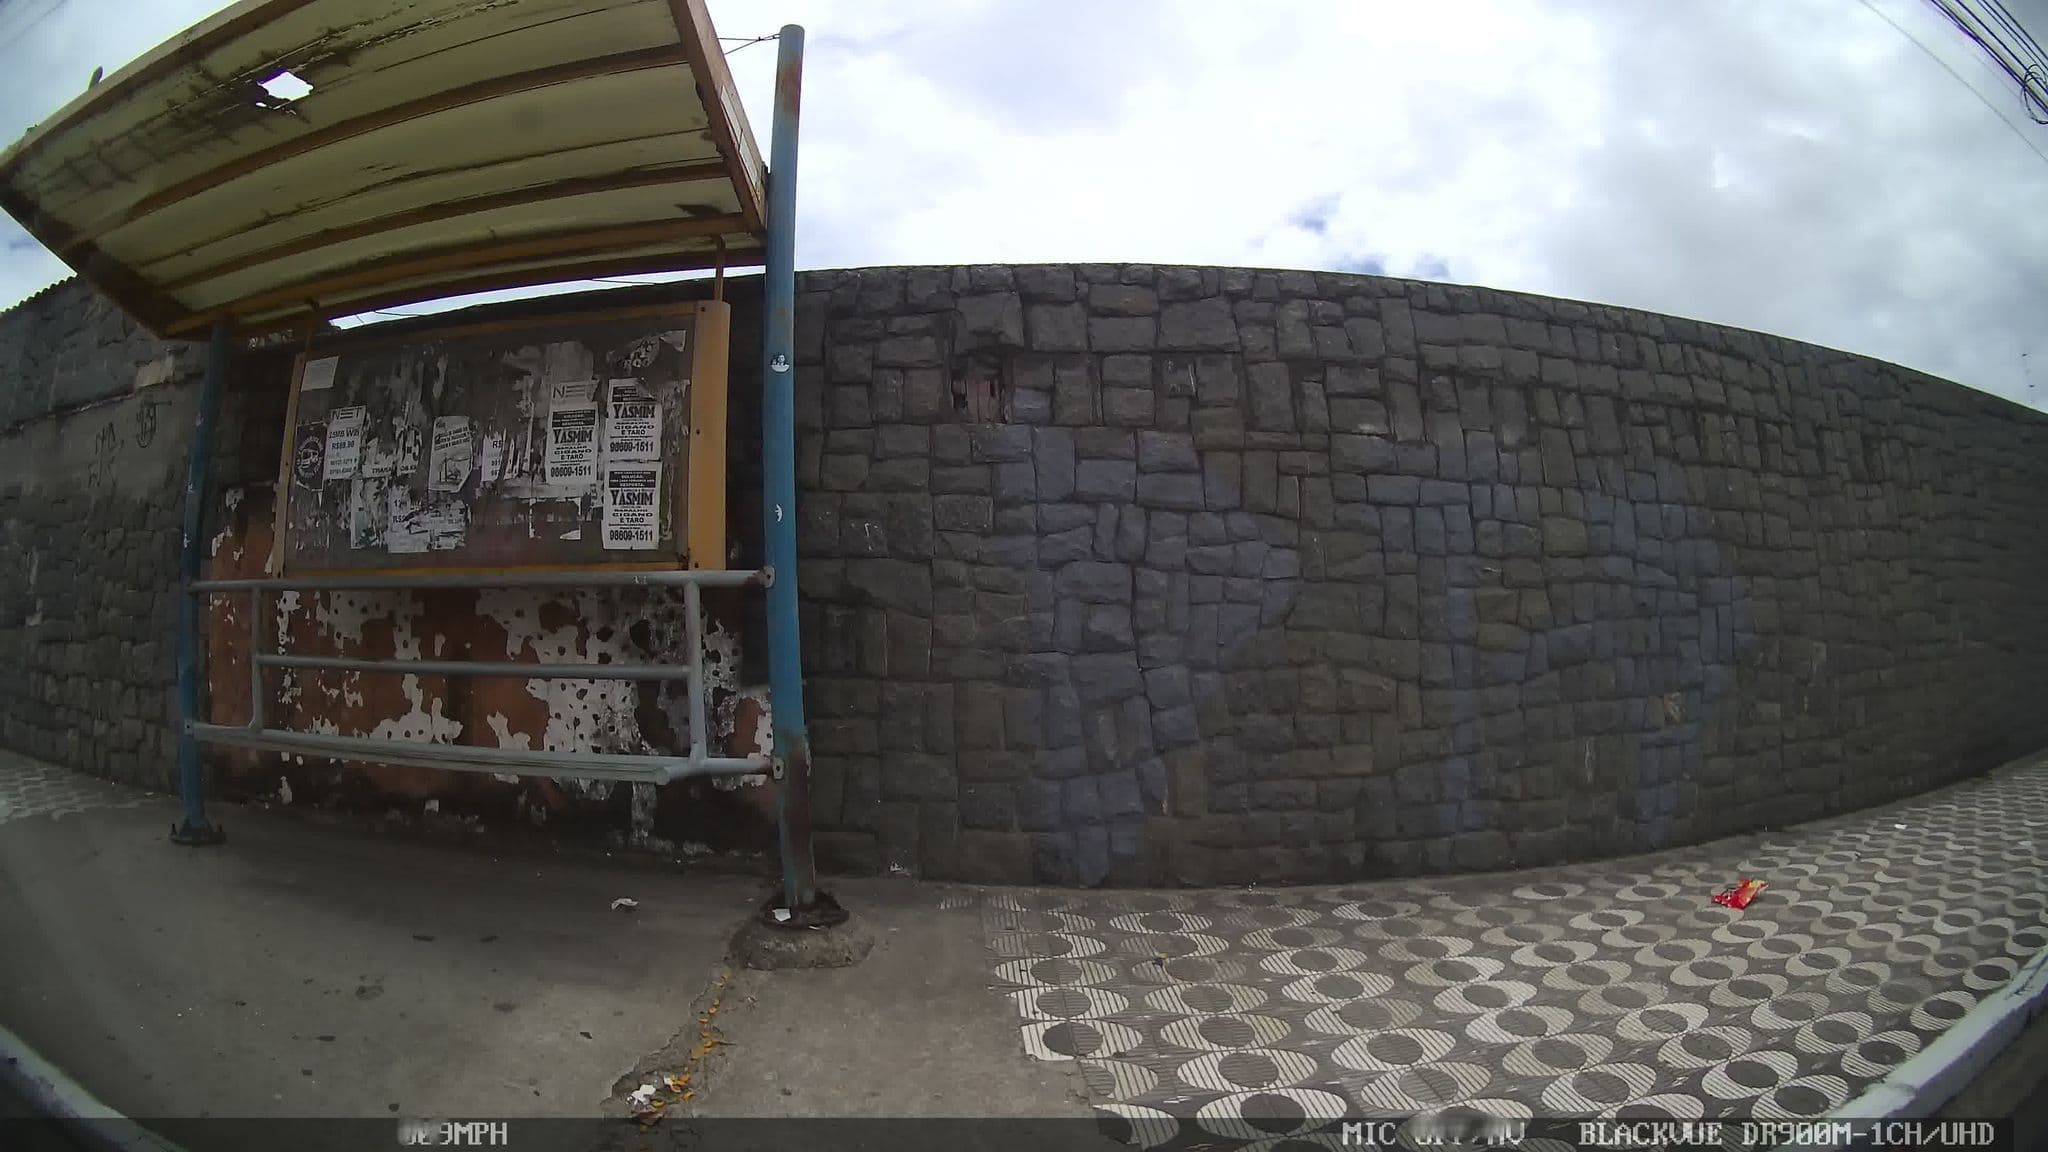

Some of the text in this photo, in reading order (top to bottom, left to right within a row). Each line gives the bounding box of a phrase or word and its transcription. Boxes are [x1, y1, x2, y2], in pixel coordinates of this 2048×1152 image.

[613, 404, 656, 419] YASMIM
[553, 429, 593, 444] YASMIM
[610, 490, 653, 506] YASMIM
[609, 530, 653, 541] 98609-1511
